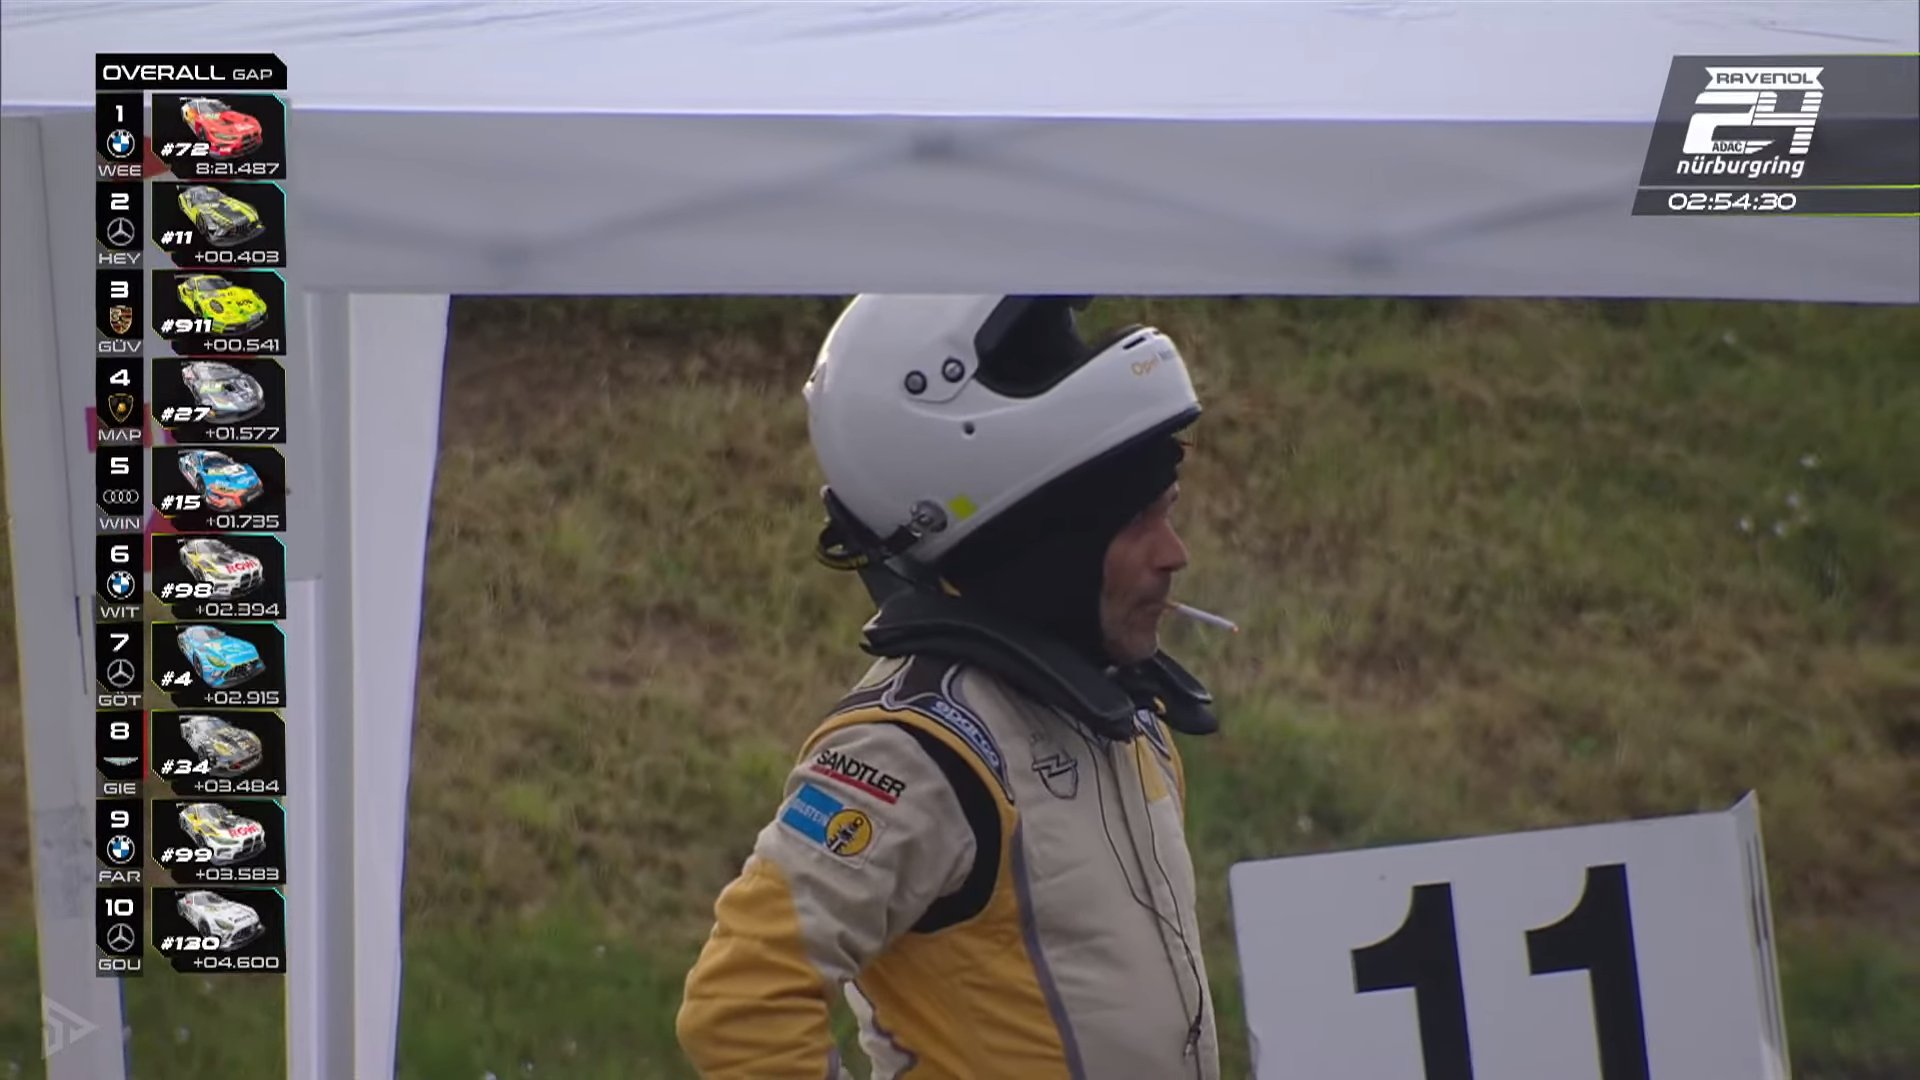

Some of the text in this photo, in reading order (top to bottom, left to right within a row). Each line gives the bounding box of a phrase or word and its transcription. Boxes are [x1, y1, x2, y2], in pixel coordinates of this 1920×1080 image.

[931, 701, 999, 768] sparco
[817, 750, 906, 798] SANDTLER
[1351, 863, 1650, 1080] 11
